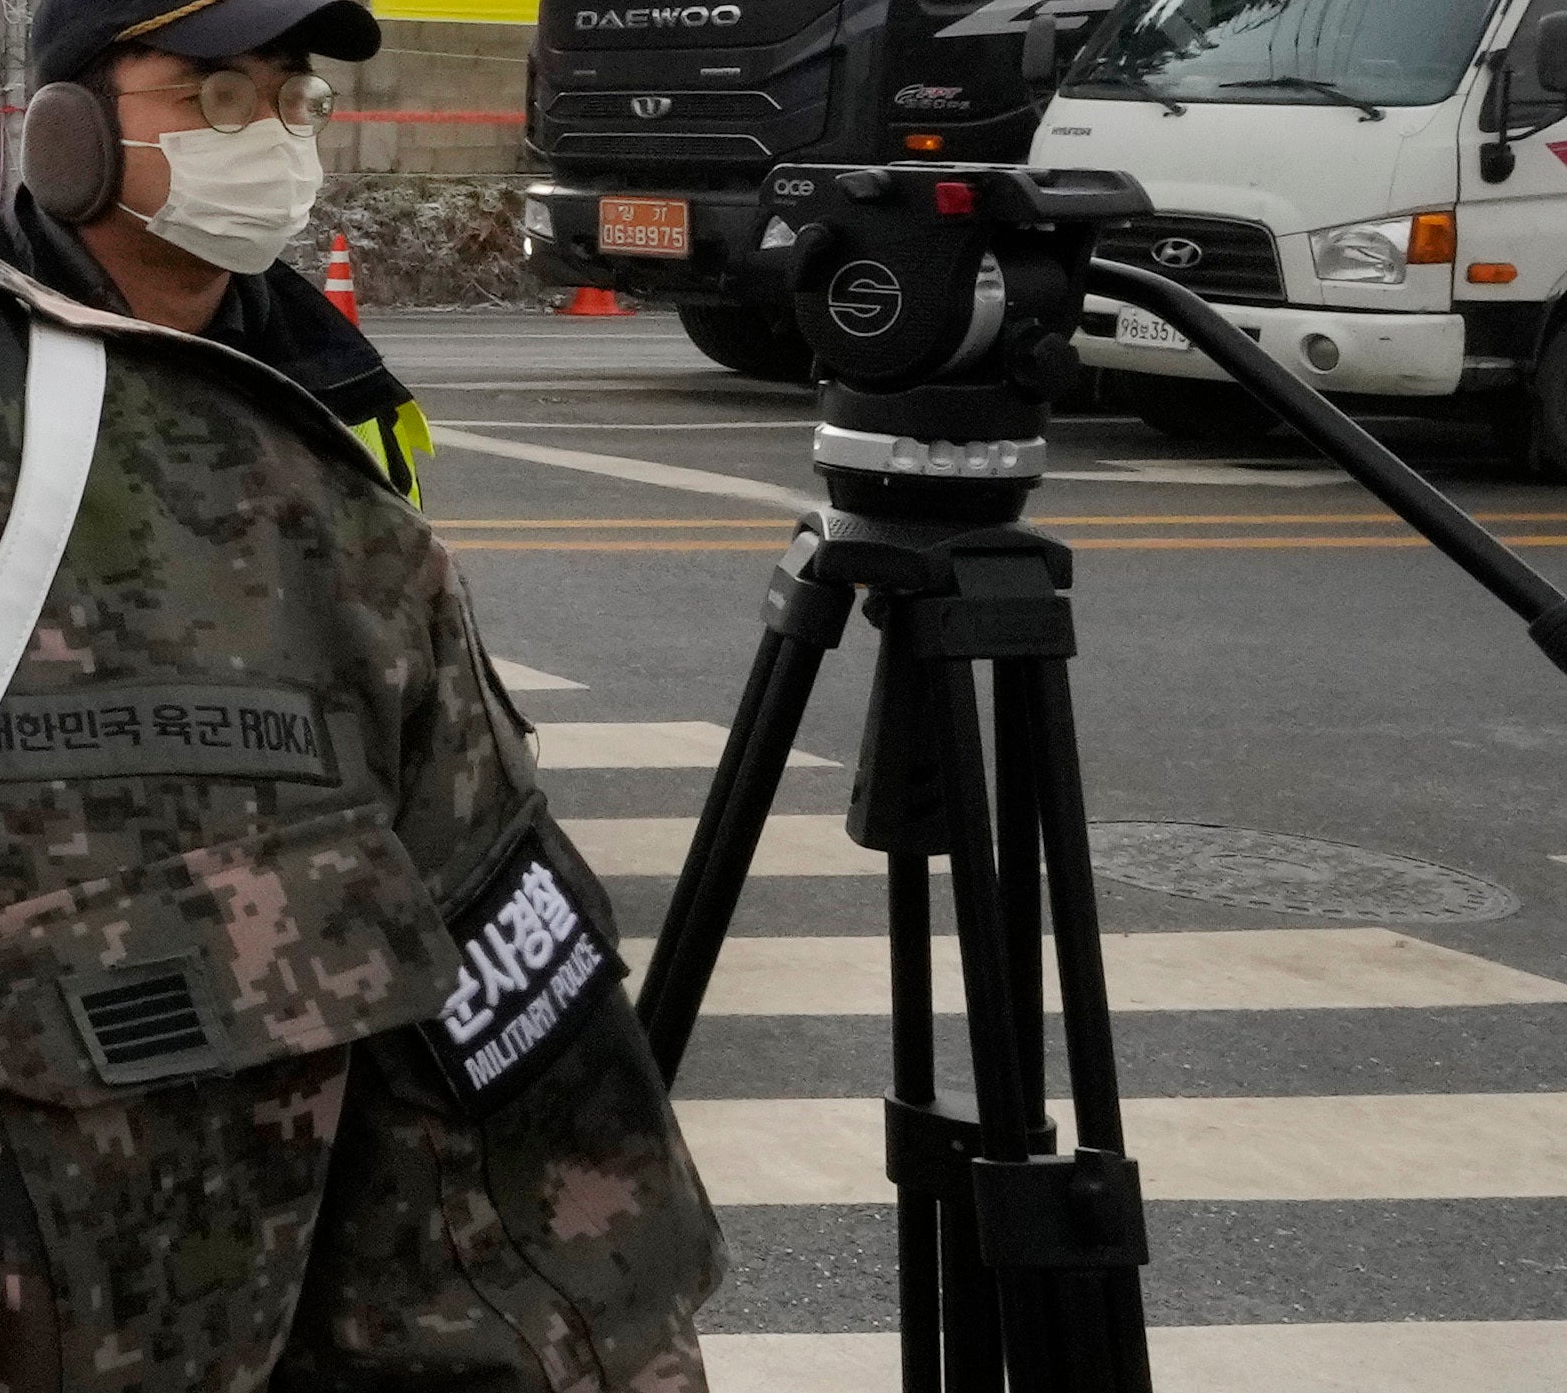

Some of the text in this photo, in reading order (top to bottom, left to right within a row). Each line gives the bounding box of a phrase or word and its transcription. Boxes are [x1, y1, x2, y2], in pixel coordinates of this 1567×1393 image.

[575, 4, 741, 31] DAEWOO
[774, 178, 815, 196] ace
[153, 703, 232, 748] 육군
[239, 708, 318, 758] ROKA
[464, 931, 603, 1091] MILITARY POLICE
